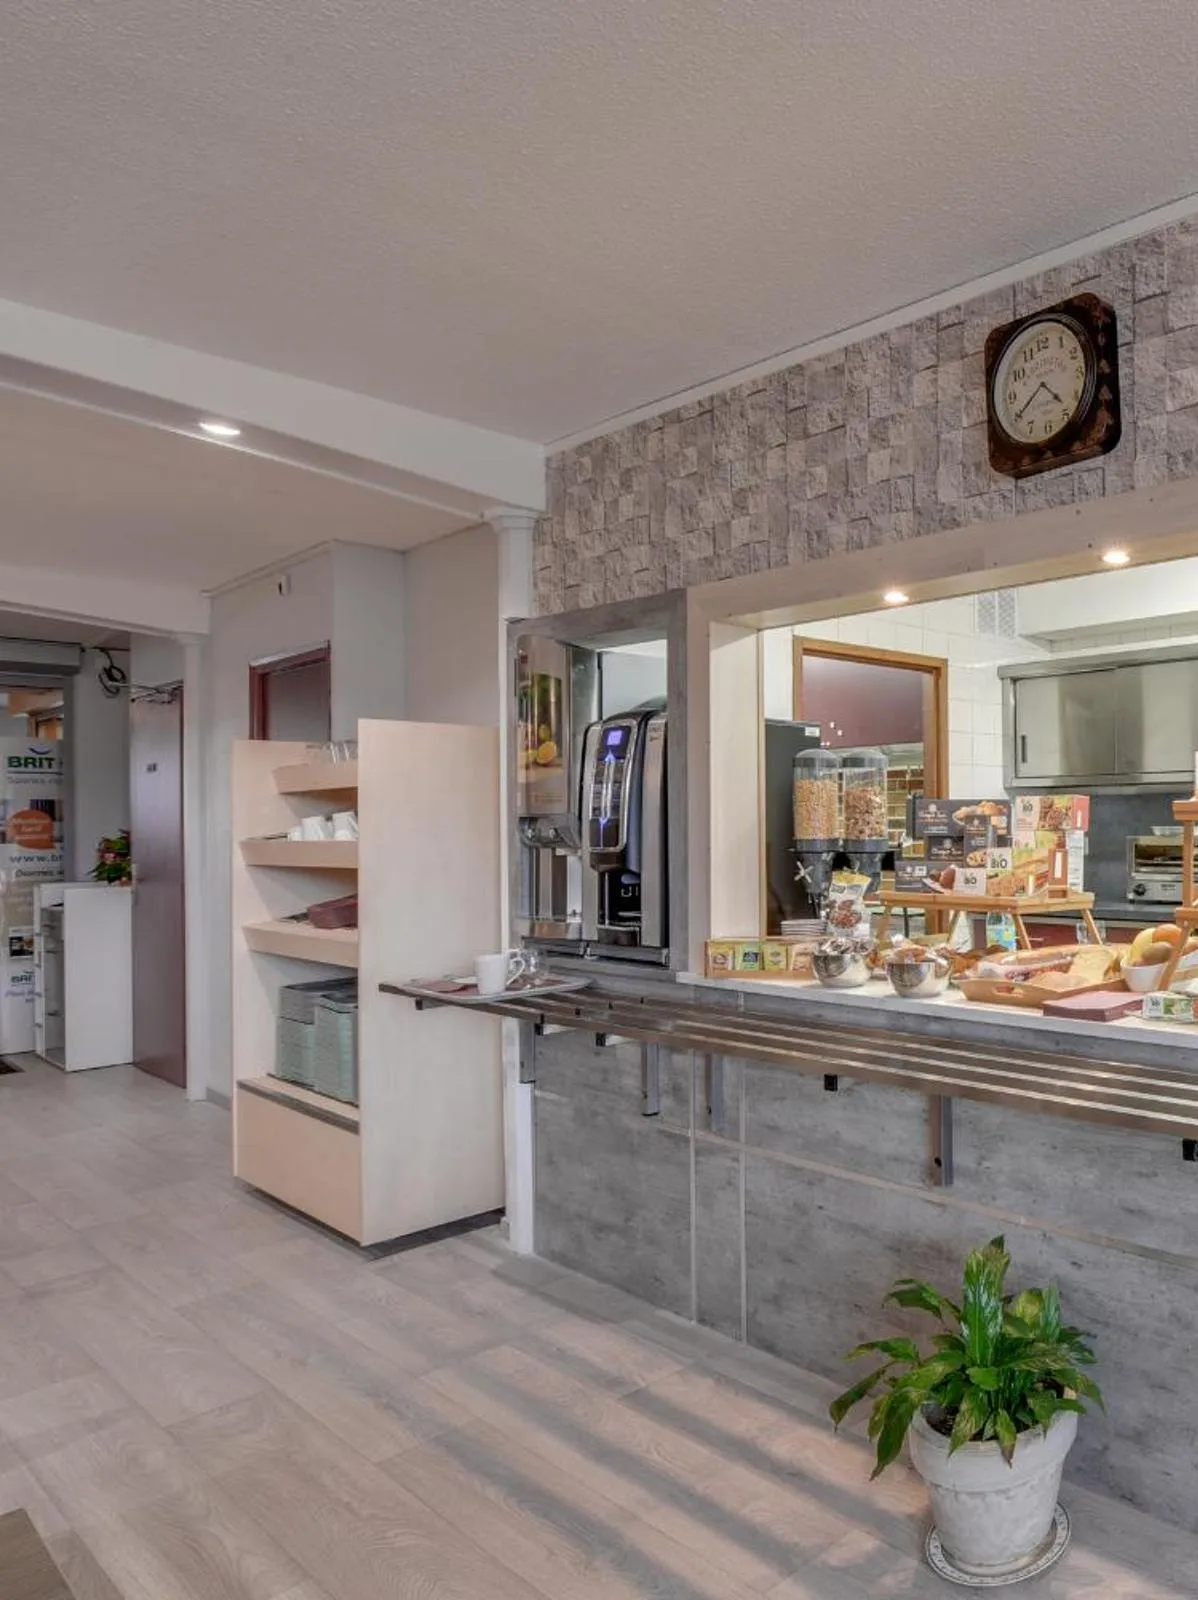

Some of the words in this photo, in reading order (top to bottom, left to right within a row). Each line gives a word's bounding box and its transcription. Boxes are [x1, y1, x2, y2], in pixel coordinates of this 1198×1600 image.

[1036, 336, 1049, 353] 12
[1023, 347, 1034, 362] 11
[1013, 366, 1026, 383] 10
[7, 755, 55, 770] BRIT
